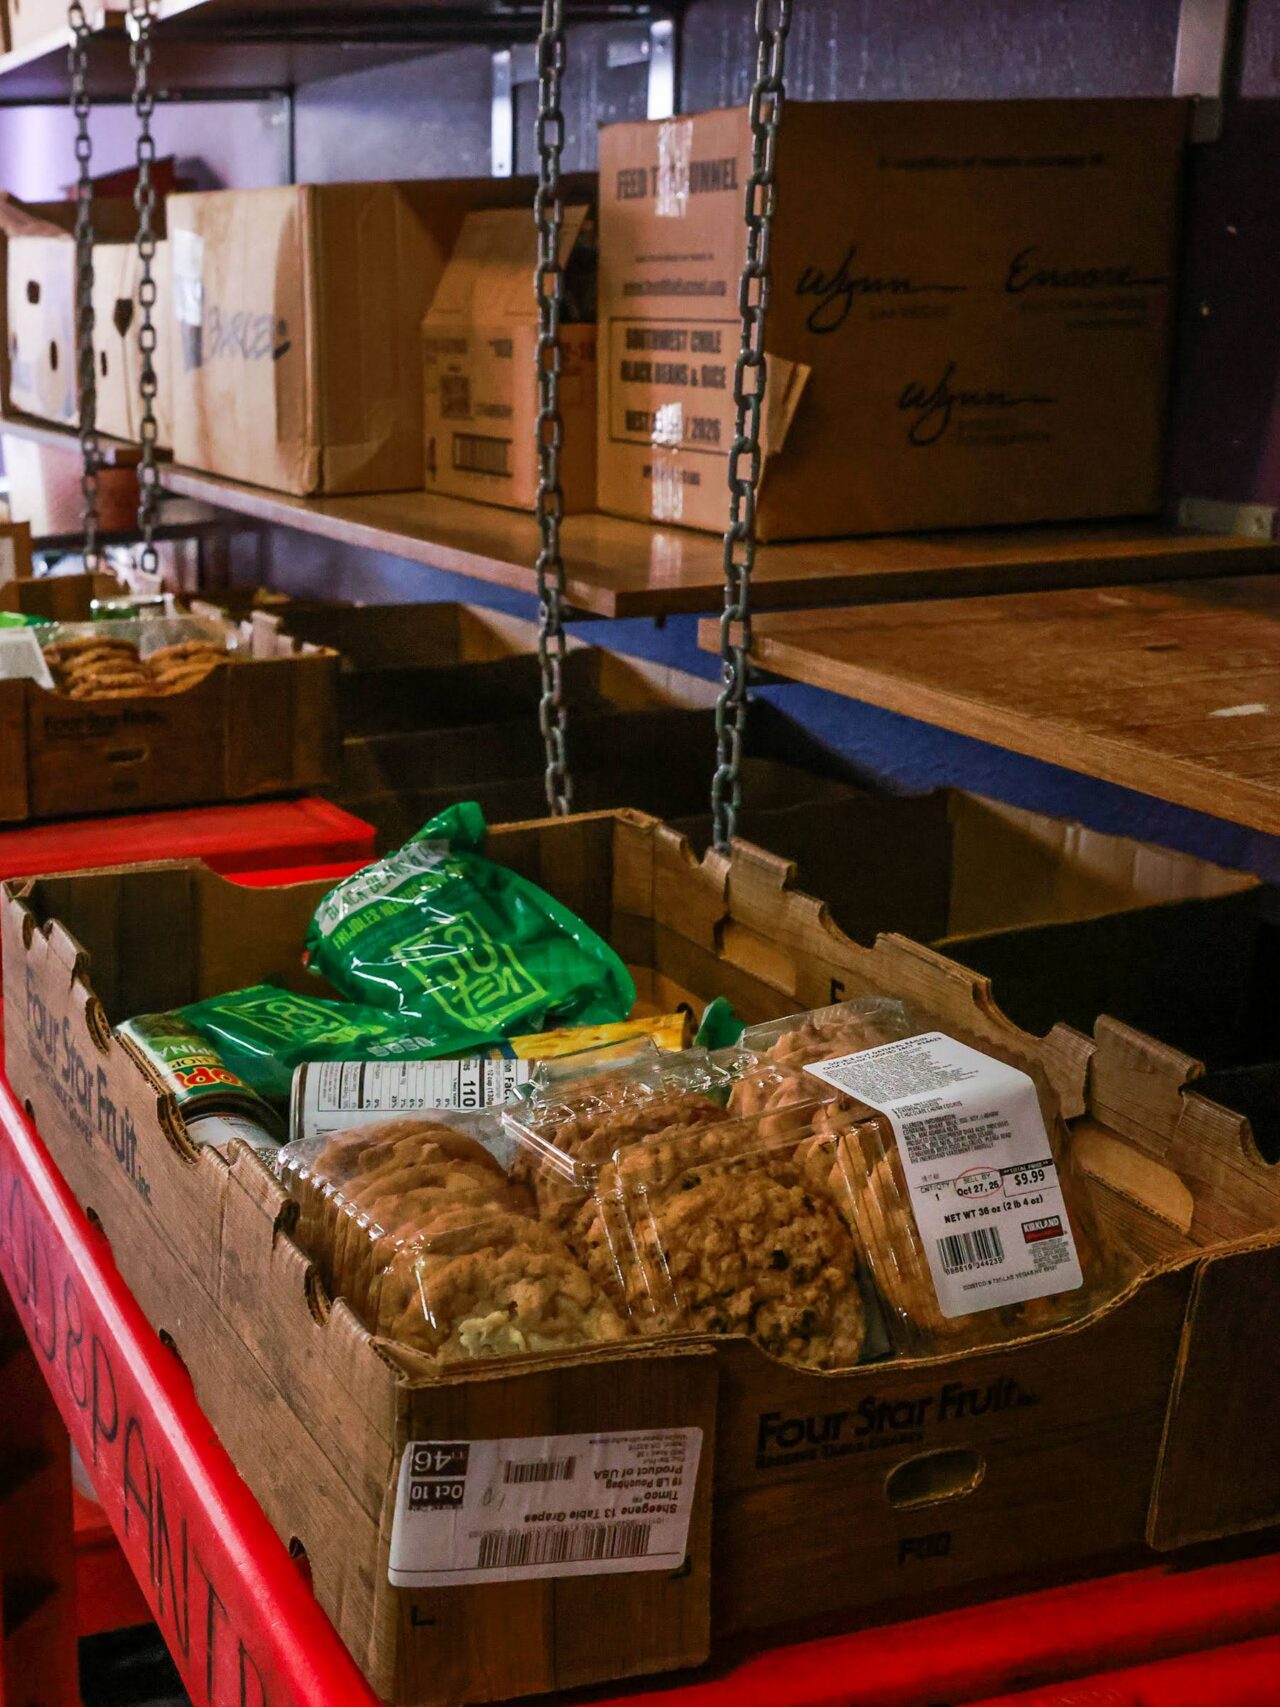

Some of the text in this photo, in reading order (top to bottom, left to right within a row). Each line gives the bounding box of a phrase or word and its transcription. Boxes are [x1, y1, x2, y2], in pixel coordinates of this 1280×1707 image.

[618, 168, 647, 200] FEED
[686, 157, 738, 194] UNNEL
[1005, 246, 1170, 294] Encore
[621, 361, 651, 382] BLACK
[655, 363, 688, 385] BEANS
[26, 966, 60, 1064] Four
[62, 1016, 93, 1118] Star
[97, 1065, 137, 1179] Fruit
[463, 1081, 476, 1107] 110
[1013, 1168, 1046, 1187] $9.99
[956, 1186, 972, 1196] Oct
[973, 1182, 987, 1193] 27,
[943, 1193, 1044, 1223] NET WT 36 oz (2 lb 4 oz)
[1022, 1215, 1059, 1233] KIRKLAND
[757, 1408, 850, 1453] Four
[854, 1394, 934, 1436] Star
[938, 1376, 1018, 1422] Fruit
[414, 1450, 451, 1472] 46
[593, 1465, 683, 1480] Product of USA
[654, 1477, 670, 1488] LB
[411, 1483, 463, 1500] Oct 10
[524, 1502, 678, 1522] Sheegene 13 Table Grapes
